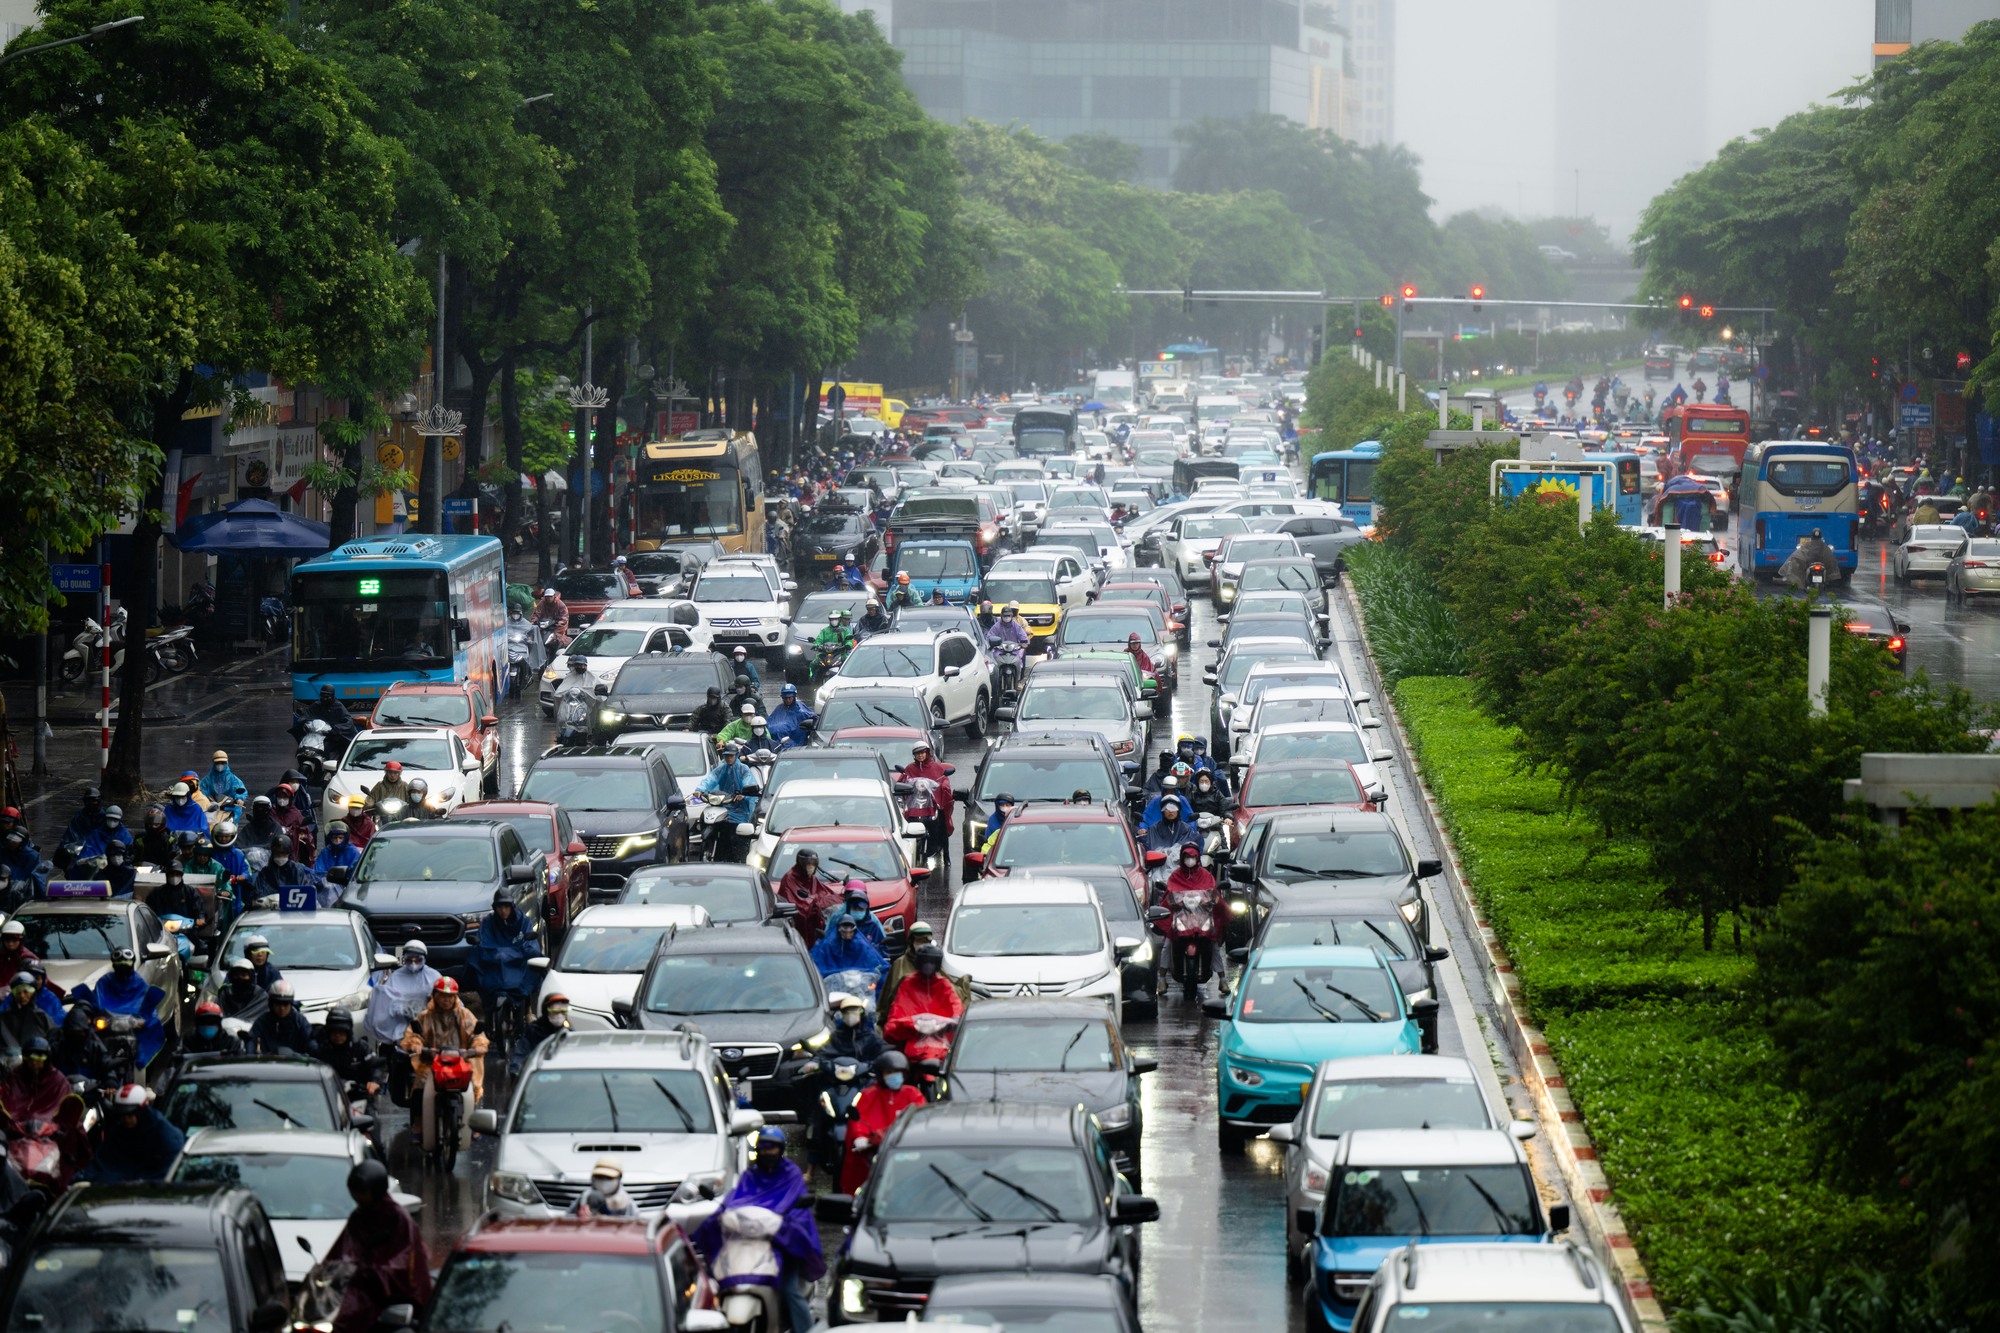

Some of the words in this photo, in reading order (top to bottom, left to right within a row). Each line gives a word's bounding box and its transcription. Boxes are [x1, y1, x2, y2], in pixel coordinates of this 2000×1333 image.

[1701, 306, 1712, 317] 05
[653, 473, 720, 481] LIMOUSINE
[70, 579, 92, 589] QUANG
[945, 588, 964, 597] Petrol
[288, 888, 308, 909] G7
